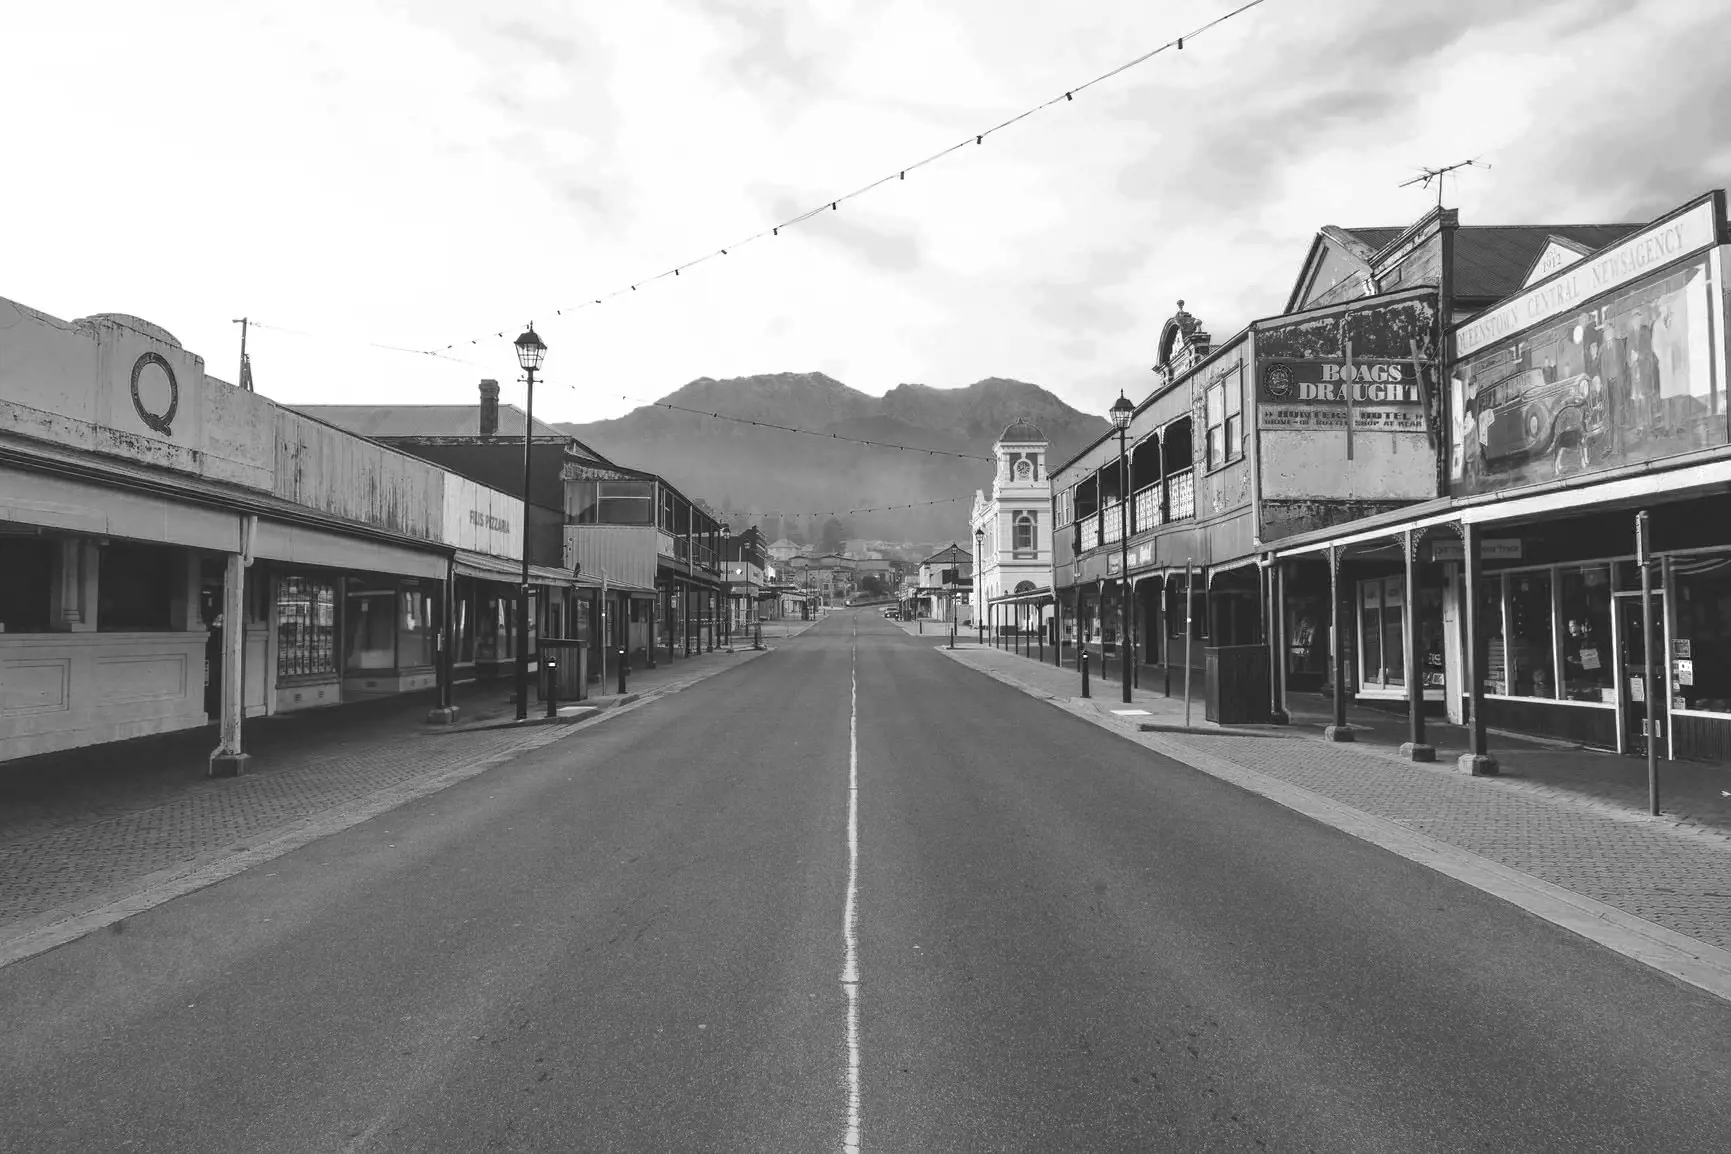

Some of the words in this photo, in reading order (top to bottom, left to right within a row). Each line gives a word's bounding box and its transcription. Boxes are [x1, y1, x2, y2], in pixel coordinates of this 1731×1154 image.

[1543, 253, 1561, 272] 1912
[1457, 305, 1519, 355] QUEENSTOWN
[1527, 276, 1580, 318] CENTRAL
[1591, 223, 1686, 289] NEWSAGENCY
[1320, 364, 1402, 382] BOAGS
[1298, 383, 1419, 401] DRAUGHT
[1360, 412, 1410, 421] HOTEL
[1398, 420, 1423, 428] REAR
